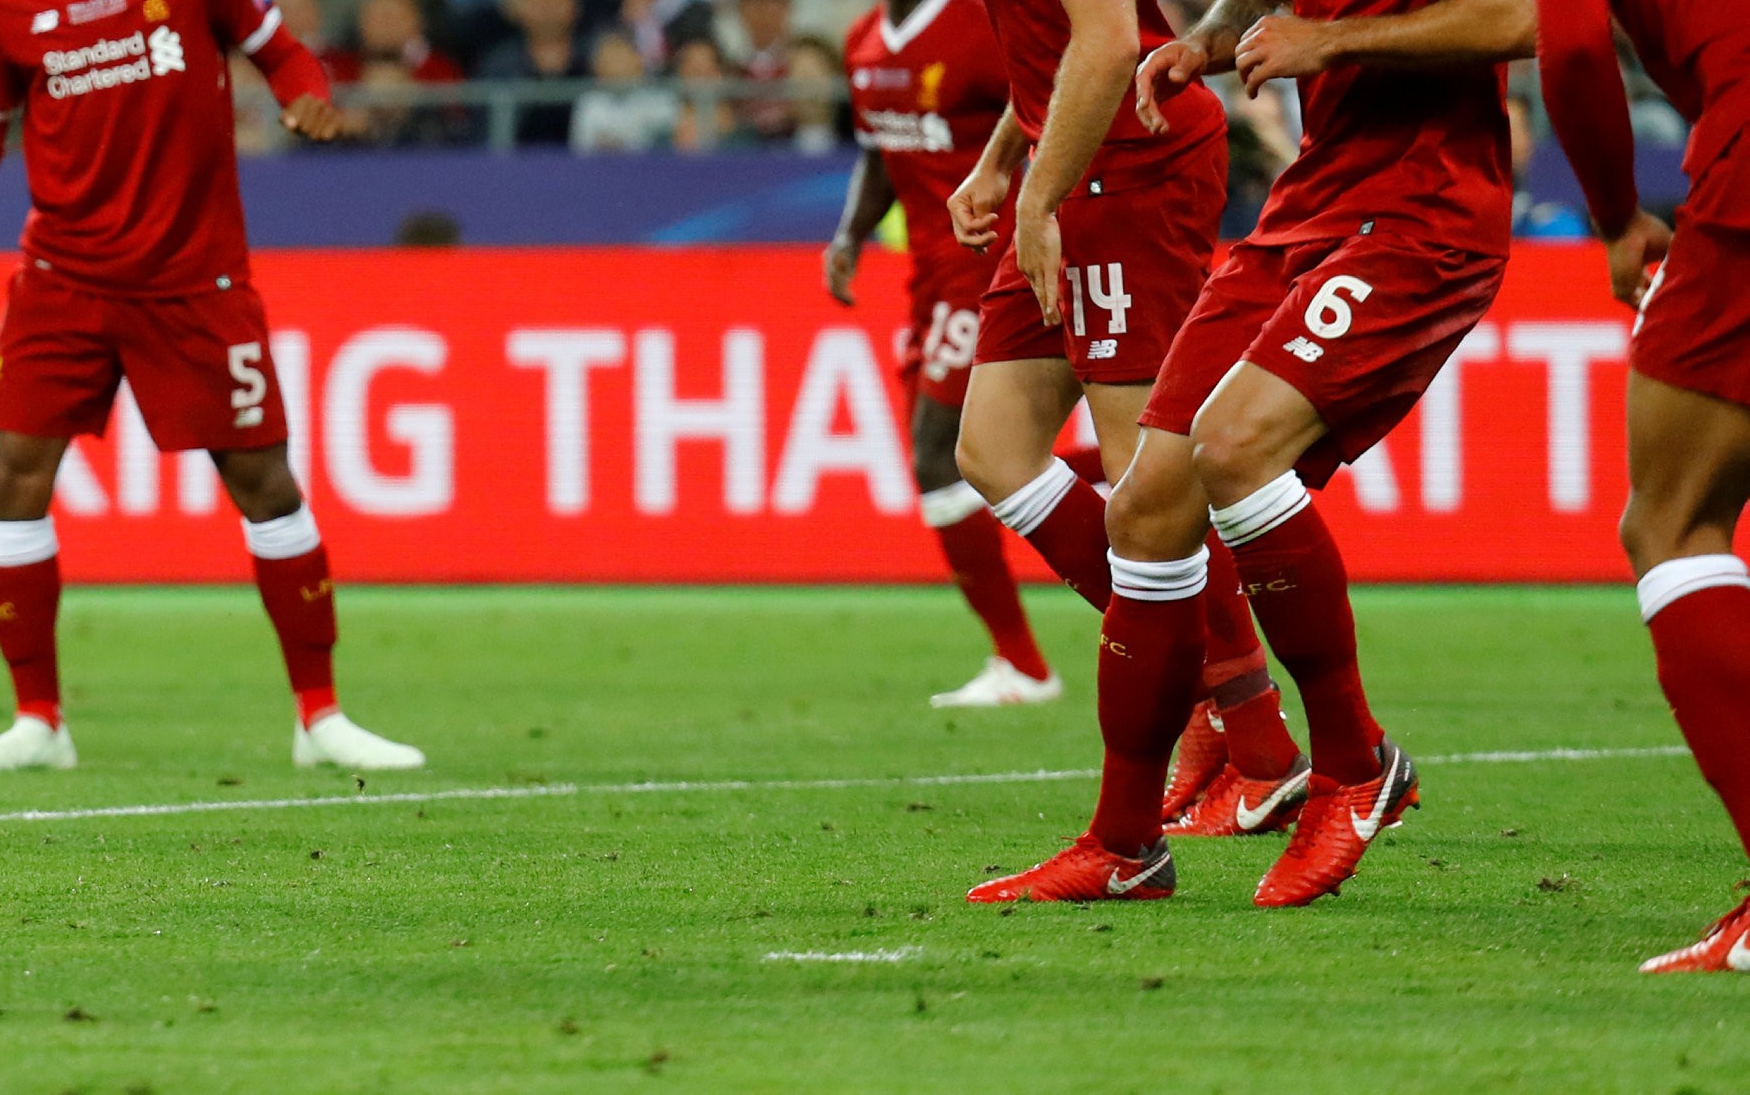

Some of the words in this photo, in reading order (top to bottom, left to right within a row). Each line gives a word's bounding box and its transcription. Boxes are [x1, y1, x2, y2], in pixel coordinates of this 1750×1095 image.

[1066, 261, 1132, 337] 14
[1304, 274, 1374, 339] 6
[923, 300, 981, 370] 19
[227, 340, 267, 409] 5
[504, 328, 914, 515] THA
